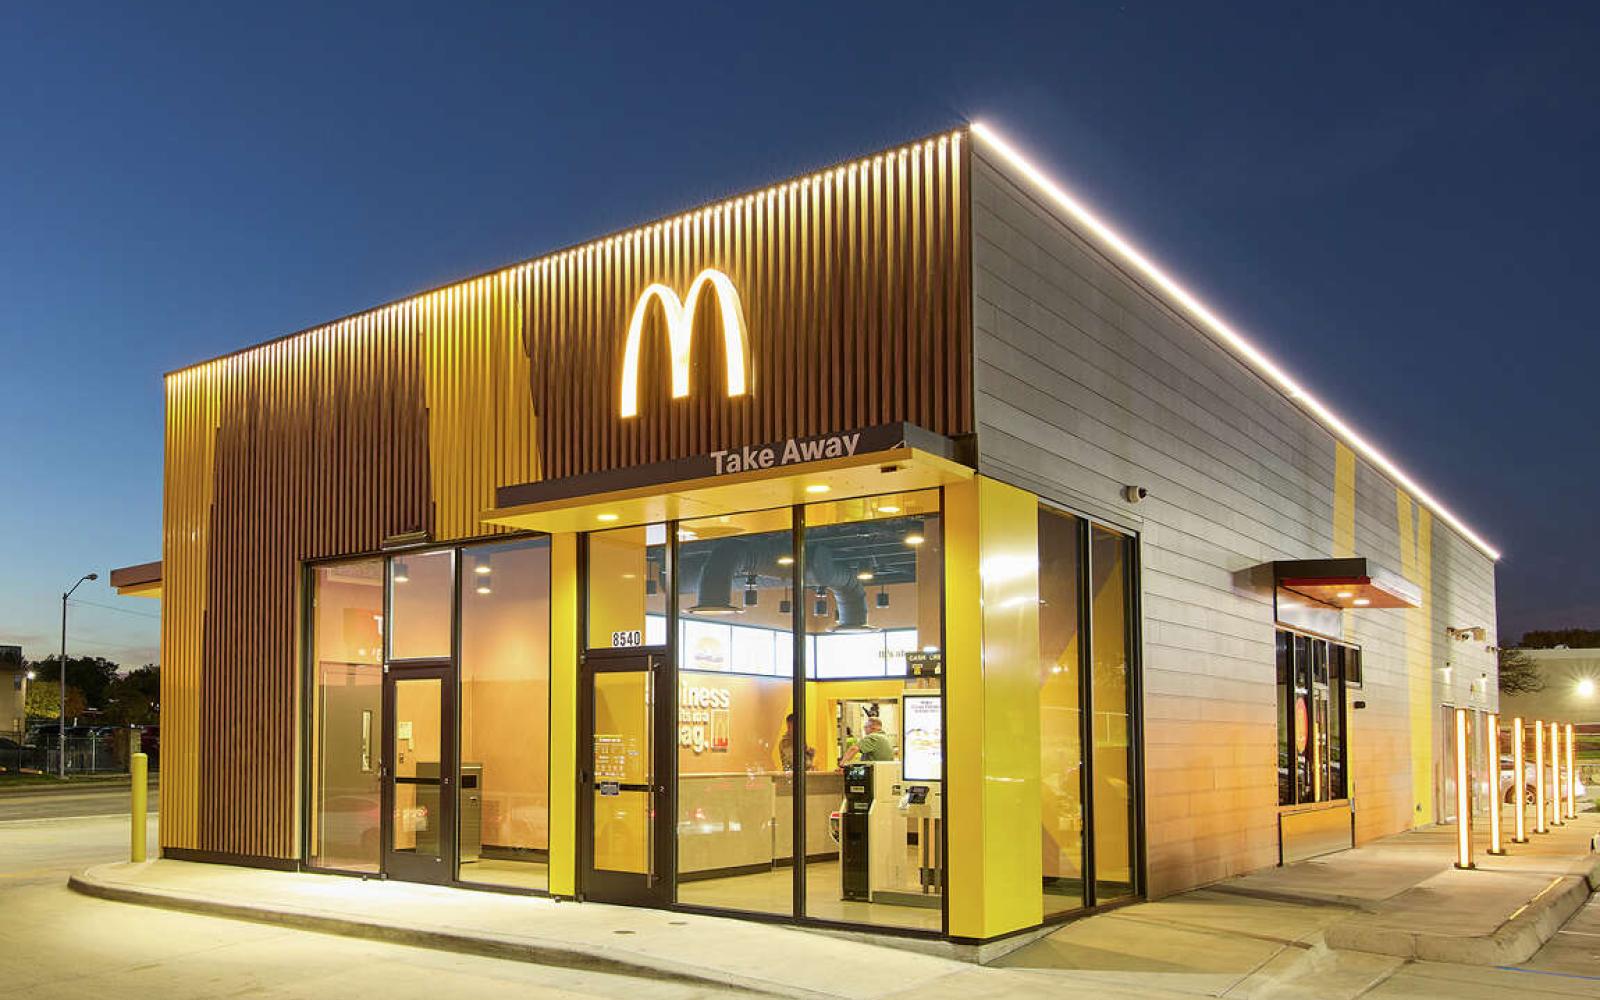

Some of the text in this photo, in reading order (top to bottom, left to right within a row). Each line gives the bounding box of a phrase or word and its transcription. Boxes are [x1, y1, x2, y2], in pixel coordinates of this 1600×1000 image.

[710, 433, 861, 475] Take Away
[613, 631, 641, 647] 8540
[680, 679, 731, 708] iness
[679, 726, 709, 754] ag.
